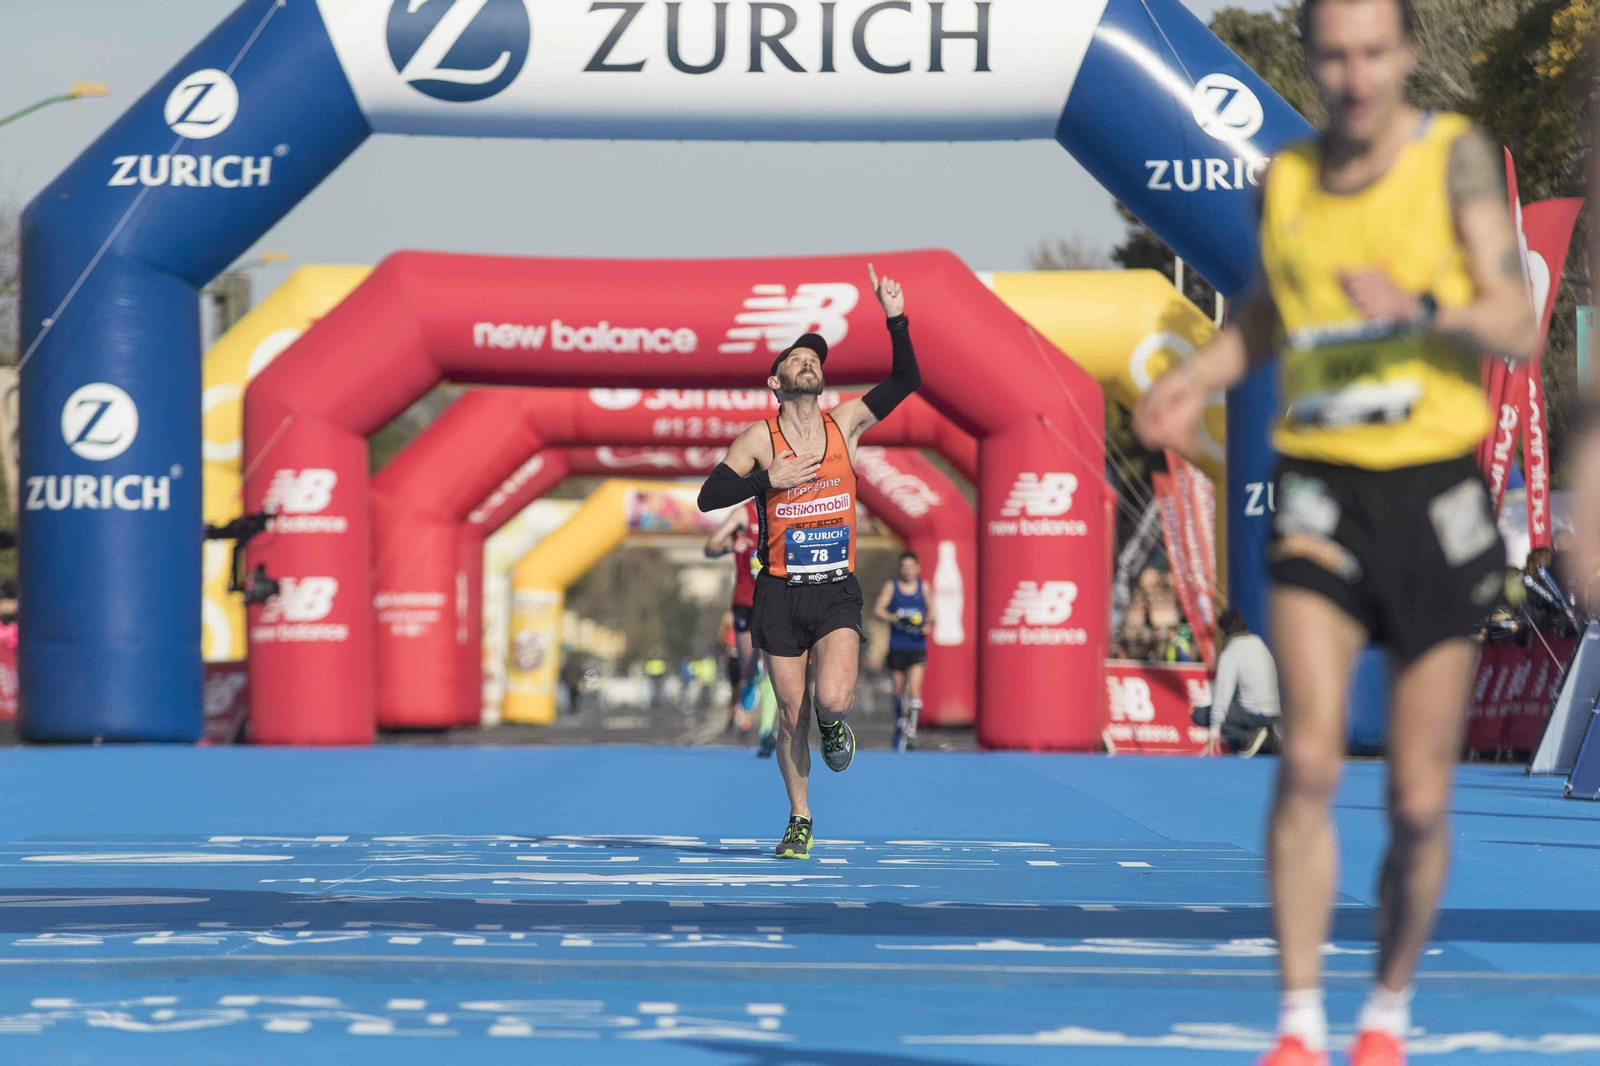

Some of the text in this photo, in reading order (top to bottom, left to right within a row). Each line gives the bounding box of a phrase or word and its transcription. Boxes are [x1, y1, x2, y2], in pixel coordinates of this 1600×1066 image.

[583, 1, 993, 75] ZURICH
[107, 154, 273, 188] ZURICH
[1144, 157, 1281, 192] ZURIC
[473, 321, 546, 350] new
[550, 319, 698, 353] balance
[25, 474, 171, 511] ZURICH
[807, 530, 843, 541] ZURICH
[1019, 517, 1087, 536] balance
[810, 548, 829, 562] 78
[1018, 626, 1087, 645] balance
[30, 994, 787, 1016] URICH
